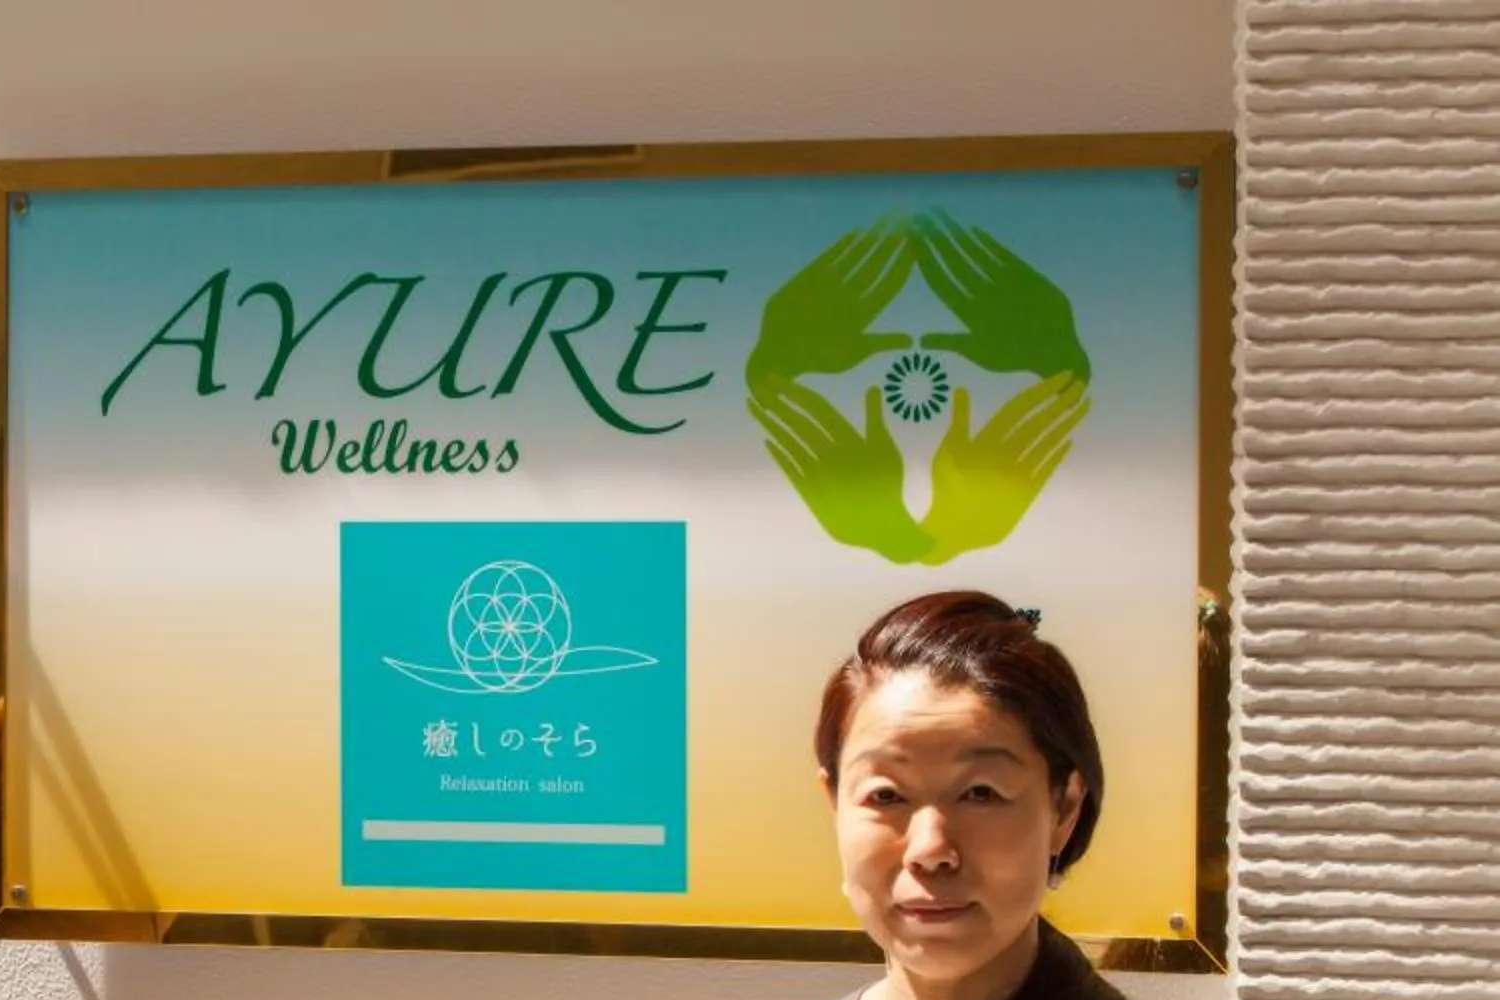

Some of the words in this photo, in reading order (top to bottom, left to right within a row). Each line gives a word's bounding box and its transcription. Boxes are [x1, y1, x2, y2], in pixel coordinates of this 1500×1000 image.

[100, 267, 728, 435] AYURE
[270, 418, 520, 474] Wellness
[422, 719, 597, 758] 癒しのそら
[439, 773, 530, 792] Relaxation
[538, 775, 585, 793] salon
